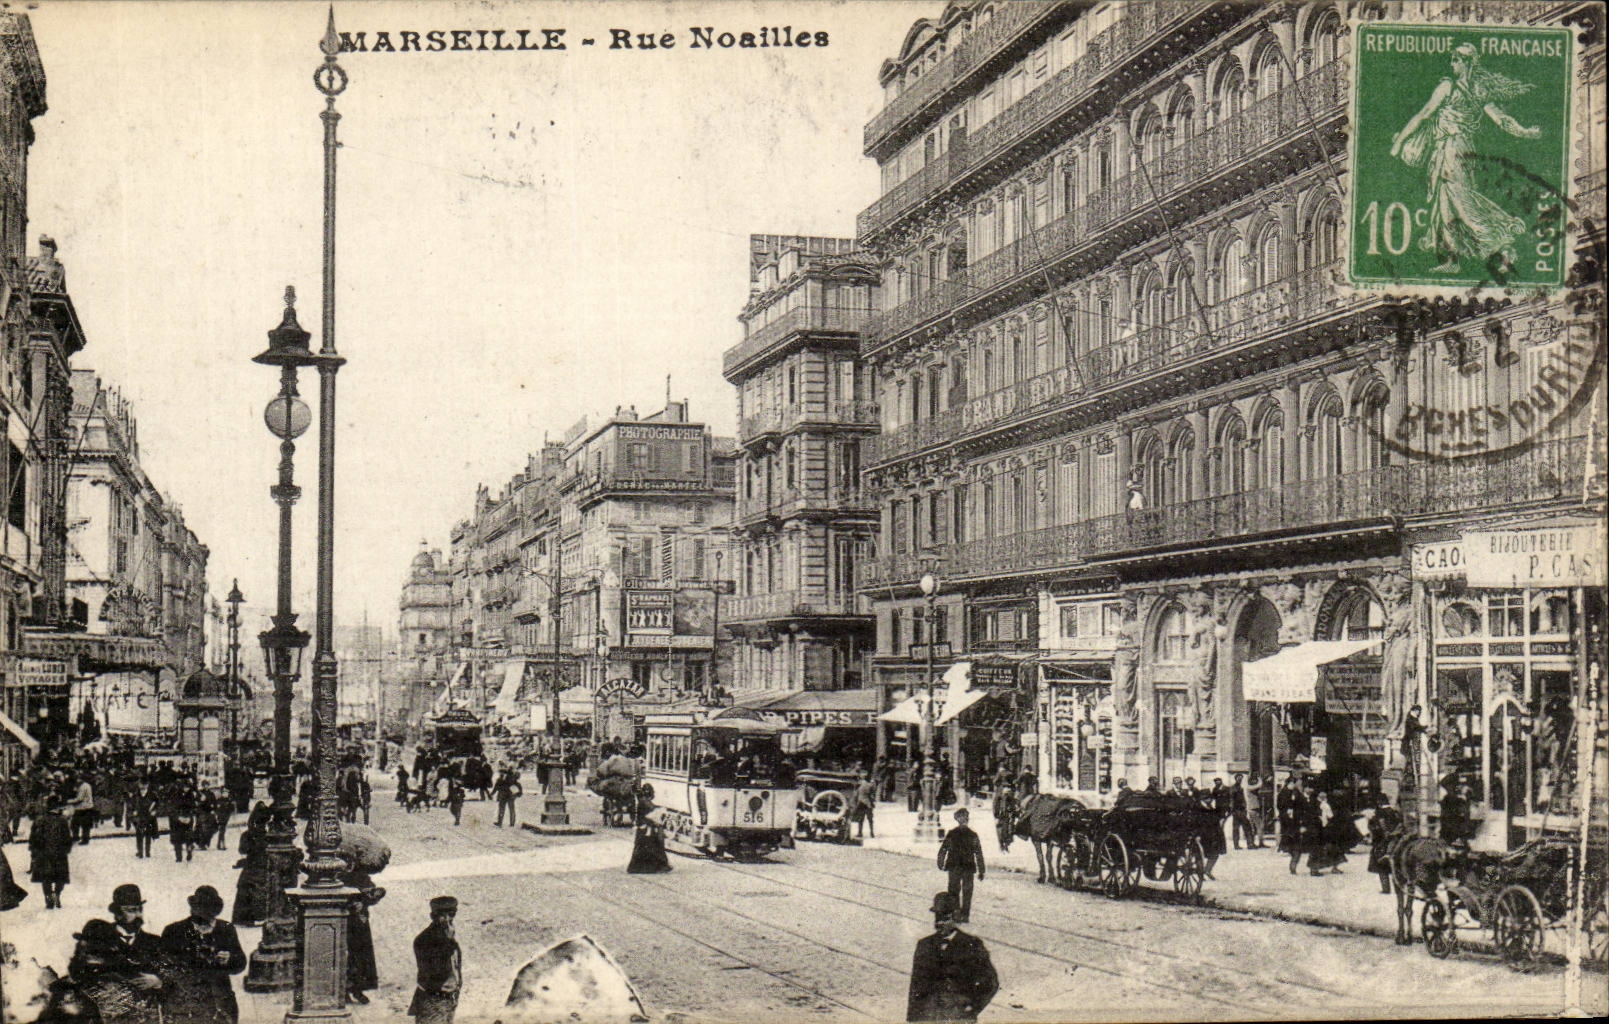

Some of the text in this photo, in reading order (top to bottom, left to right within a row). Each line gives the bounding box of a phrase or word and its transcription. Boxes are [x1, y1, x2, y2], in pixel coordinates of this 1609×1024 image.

[619, 426, 701, 440] PHOTOGRAPHIE
[1490, 531, 1573, 554] BIJOUTERIE
[1425, 546, 1466, 569] CAO
[786, 710, 852, 725] PIPES
[743, 813, 764, 823] 516
